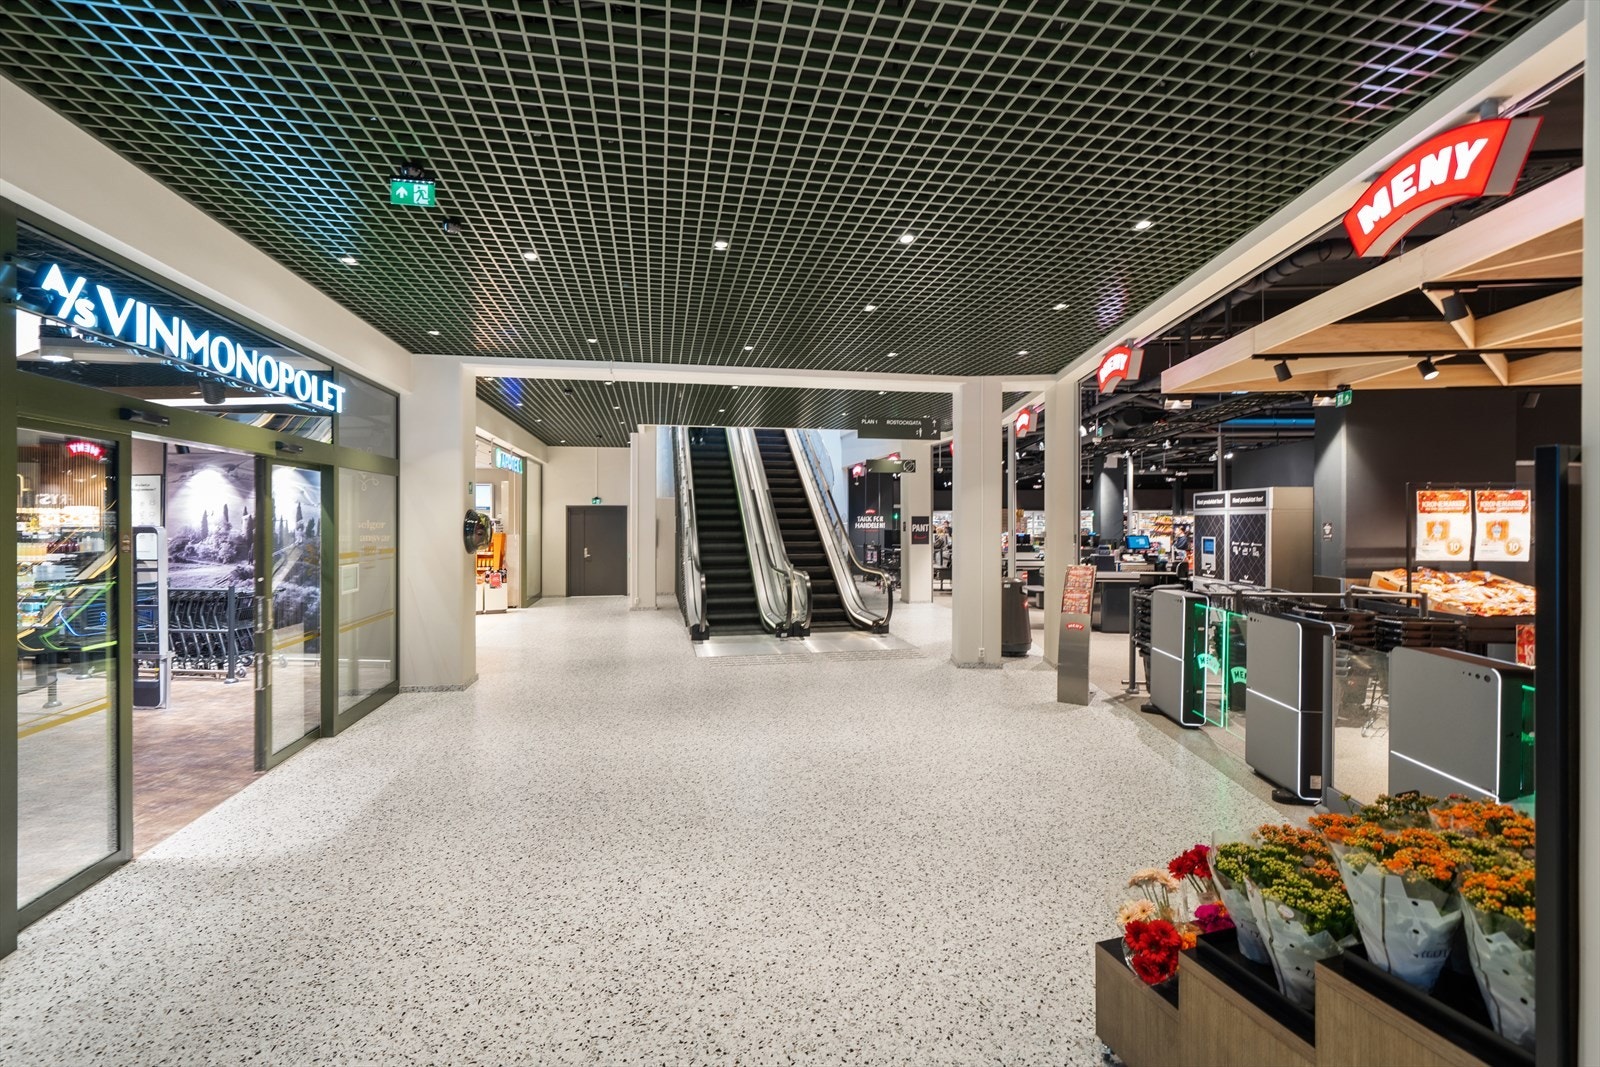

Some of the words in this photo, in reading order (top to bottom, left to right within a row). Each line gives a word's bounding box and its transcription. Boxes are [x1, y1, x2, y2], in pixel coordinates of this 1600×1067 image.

[1357, 138, 1489, 235] MENY
[96, 284, 346, 413] VINMONOPOLET
[912, 524, 928, 532] PANT
[1450, 542, 1460, 551] 10
[1508, 542, 1518, 551] 10
